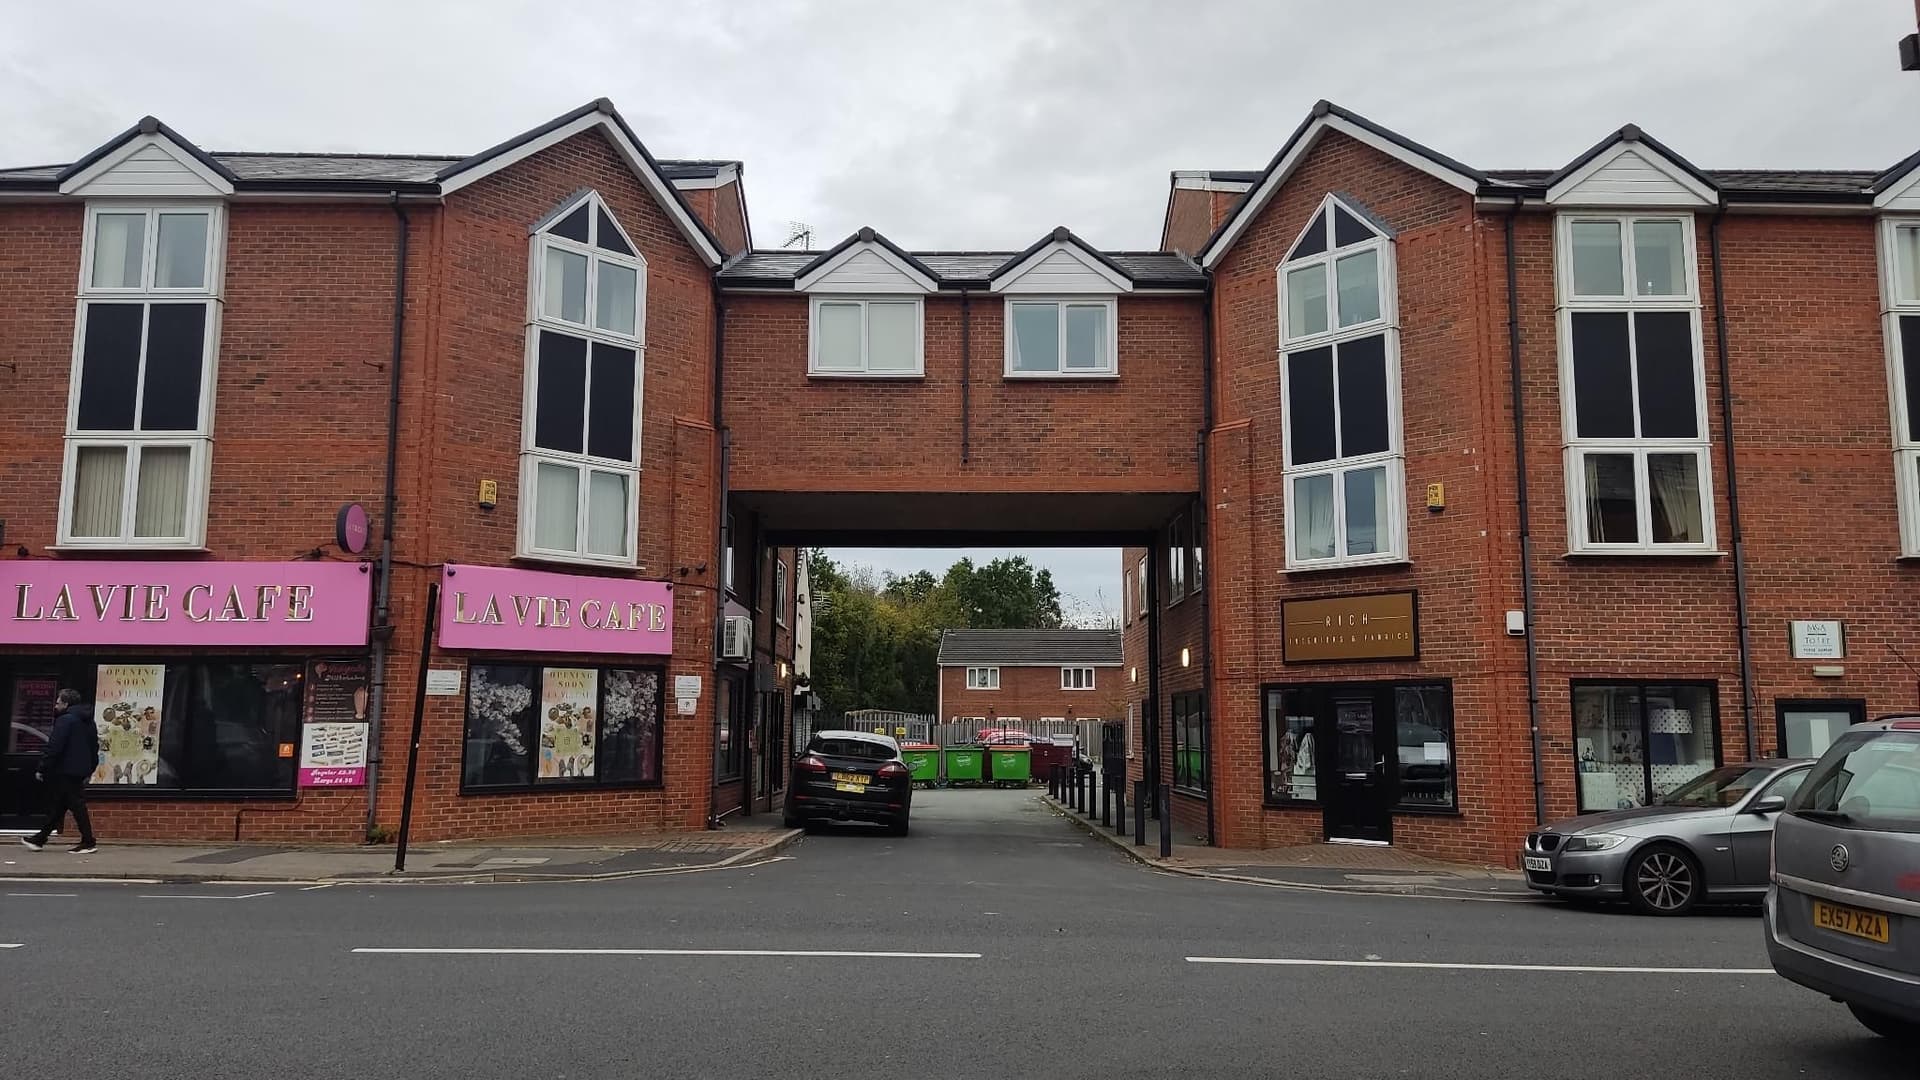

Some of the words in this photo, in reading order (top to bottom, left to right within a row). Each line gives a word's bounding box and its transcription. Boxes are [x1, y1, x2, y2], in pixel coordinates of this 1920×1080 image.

[11, 583, 80, 622] LA
[86, 583, 170, 622] VIE
[182, 583, 315, 623] CAFE
[452, 591, 506, 626] LA
[509, 593, 571, 628] VIE
[579, 599, 667, 632] CAFE
[1325, 612, 1369, 627] RICH
[1364, 631, 1409, 641] FABRICS
[1820, 905, 1852, 930] EX57
[1855, 911, 1882, 937] XZA
